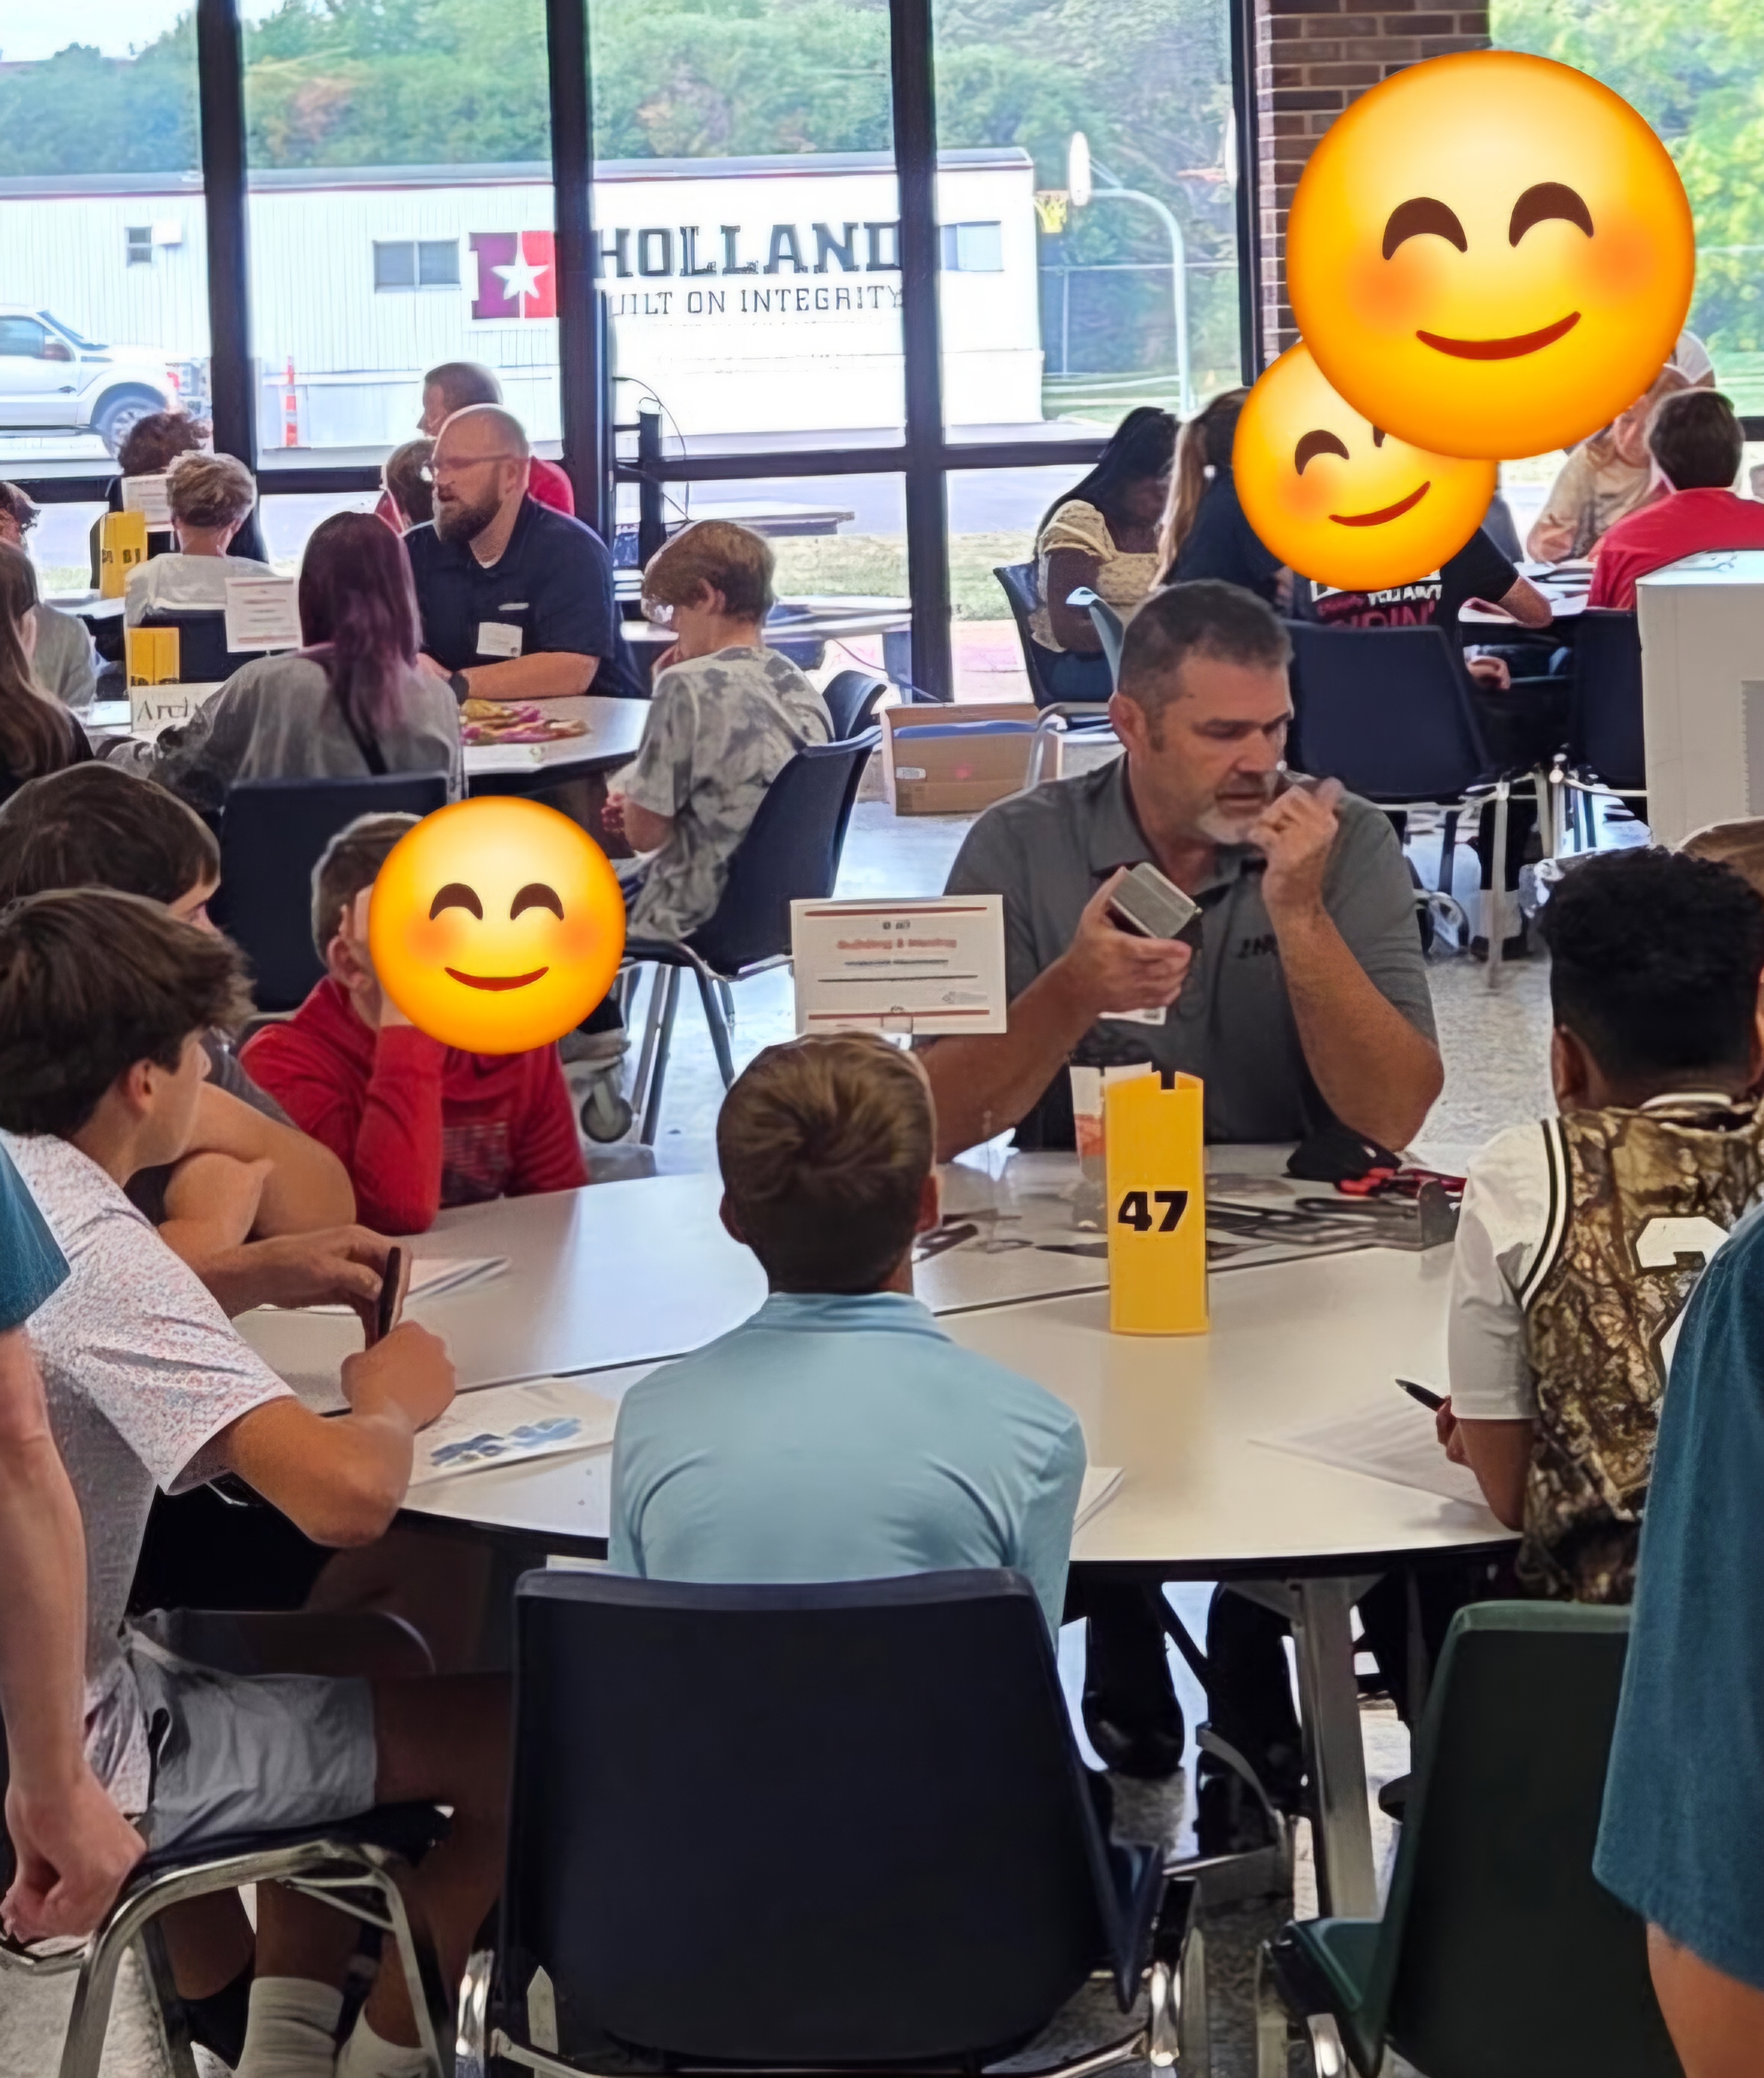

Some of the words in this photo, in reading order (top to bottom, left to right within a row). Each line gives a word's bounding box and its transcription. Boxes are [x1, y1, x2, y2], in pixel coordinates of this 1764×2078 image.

[597, 222, 902, 277] HOLLAND
[687, 291, 725, 315] ON
[741, 285, 902, 313] INTEGRITY
[1118, 1191, 1188, 1232] 47
